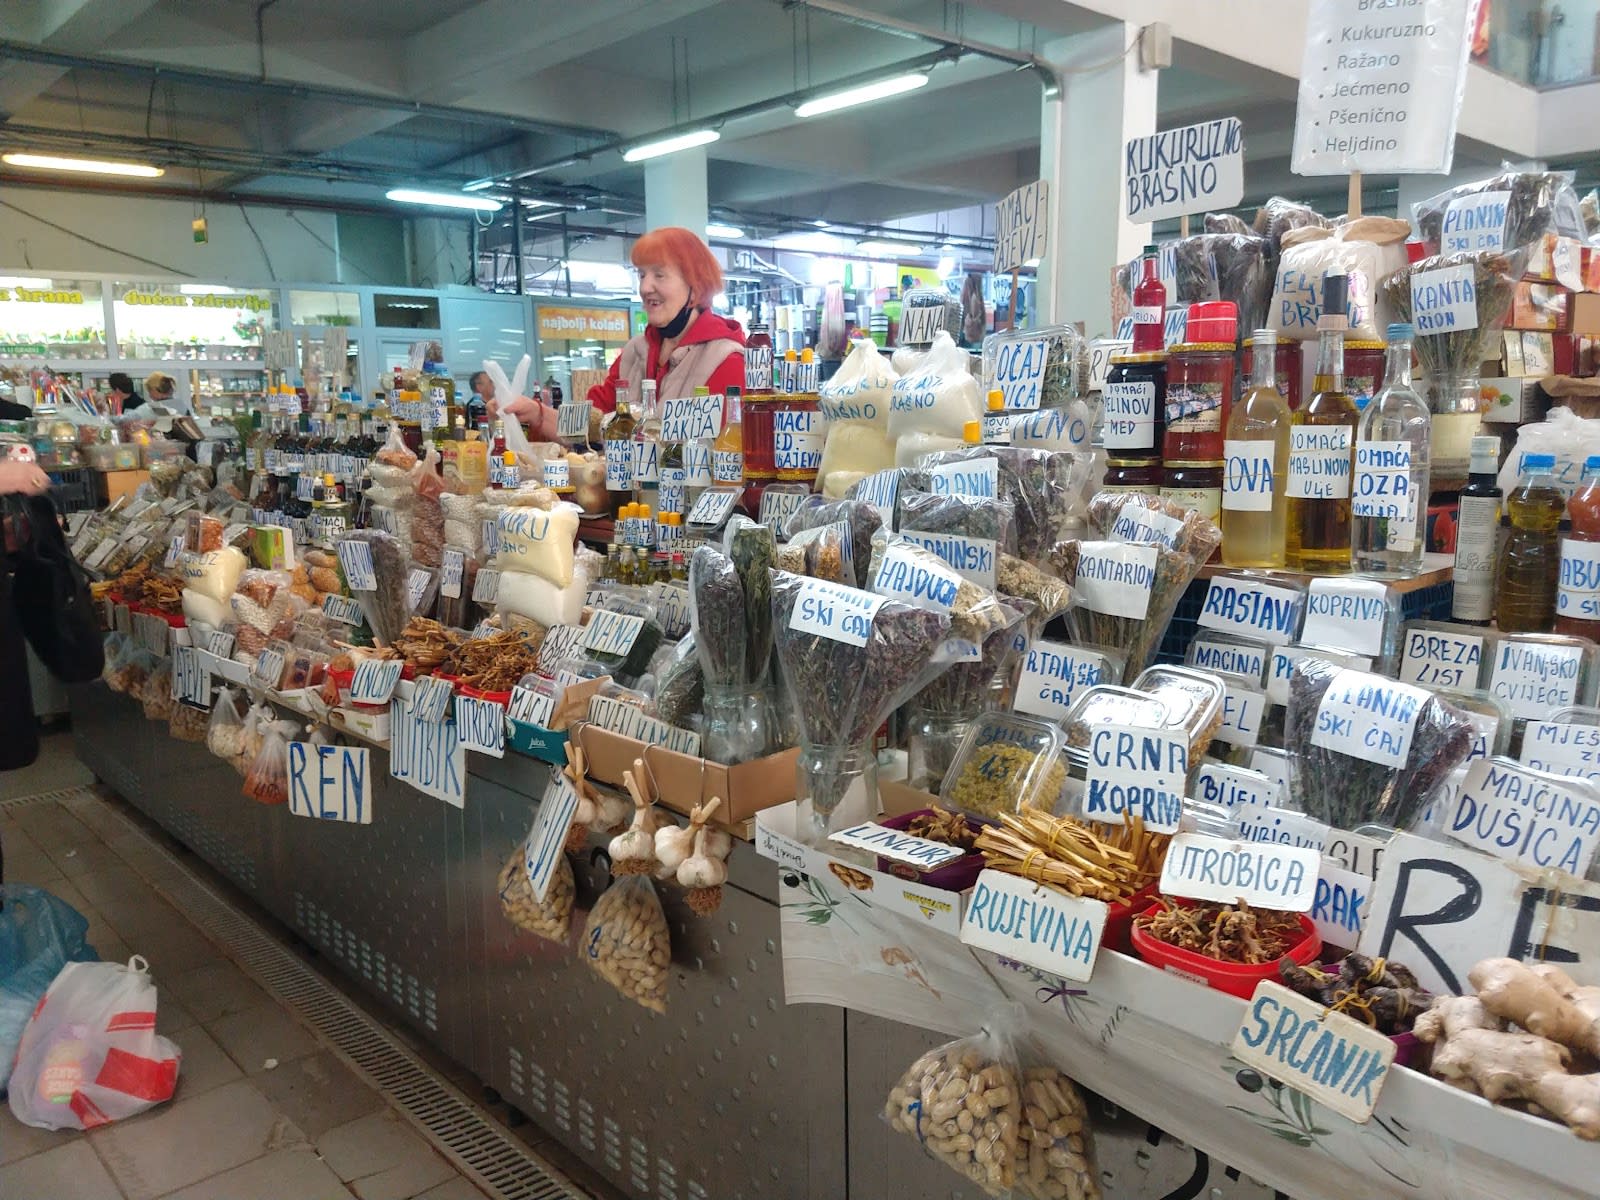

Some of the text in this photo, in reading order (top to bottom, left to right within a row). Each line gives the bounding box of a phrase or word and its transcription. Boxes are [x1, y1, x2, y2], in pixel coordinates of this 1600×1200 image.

[1341, 25, 1436, 41] Kukuruzno
[1337, 53, 1400, 70] Ražano
[1332, 80, 1410, 97] Jećmeno
[1328, 108, 1407, 125] Pšenično
[1126, 119, 1241, 177] KUKURUZNO
[1325, 136, 1397, 153] Heljdino
[902, 311, 942, 342] NANA
[1418, 312, 1456, 330] RION
[663, 416, 717, 441] RAKIJA
[1110, 419, 1136, 435] MED
[1358, 444, 1410, 468] OMAĆA
[1308, 594, 1384, 622] KOPRIVA
[584, 612, 640, 655] NANA
[1409, 633, 1481, 666] BREZA
[1416, 663, 1463, 686] LIST
[1093, 730, 1188, 774] CRNA
[290, 742, 365, 824] REN
[1481, 766, 1600, 836] MAJČINA
[1452, 793, 1584, 876] DUŠICA
[968, 883, 1093, 965] RUJEVINA
